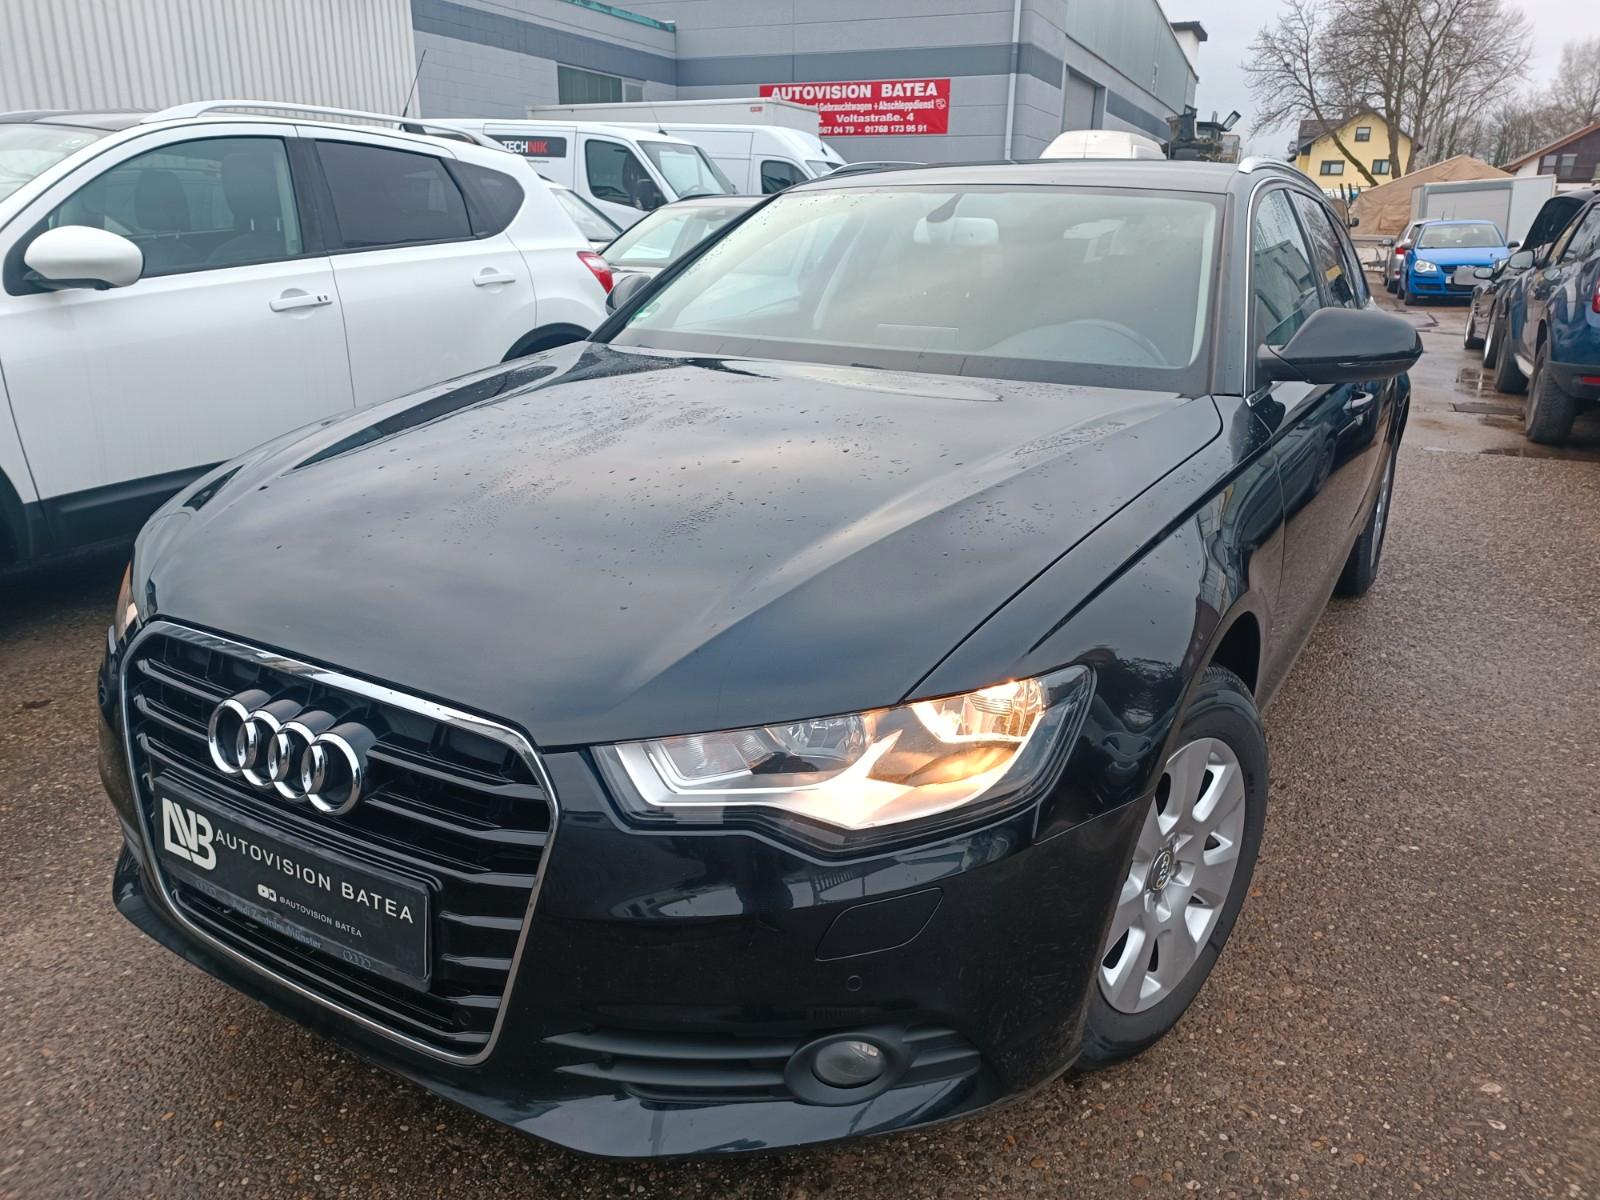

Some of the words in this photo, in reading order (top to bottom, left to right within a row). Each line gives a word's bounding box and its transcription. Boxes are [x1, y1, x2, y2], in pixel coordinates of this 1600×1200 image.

[771, 84, 872, 100] AUTOVISION
[881, 82, 938, 98] BATEA
[879, 99, 934, 112] Abschleppdienst
[836, 113, 904, 123] Voltastraße.
[906, 112, 914, 121] 4
[833, 126, 843, 134] 04
[845, 126, 855, 134] 79
[864, 125, 888, 133] 01768
[891, 125, 904, 133] 173
[906, 124, 916, 132] 95
[918, 124, 927, 132] 91
[502, 140, 548, 153] TECHNIK
[215, 828, 331, 892] AUTOVISION
[341, 882, 414, 925] BATEA
[335, 919, 363, 938] BATEA
